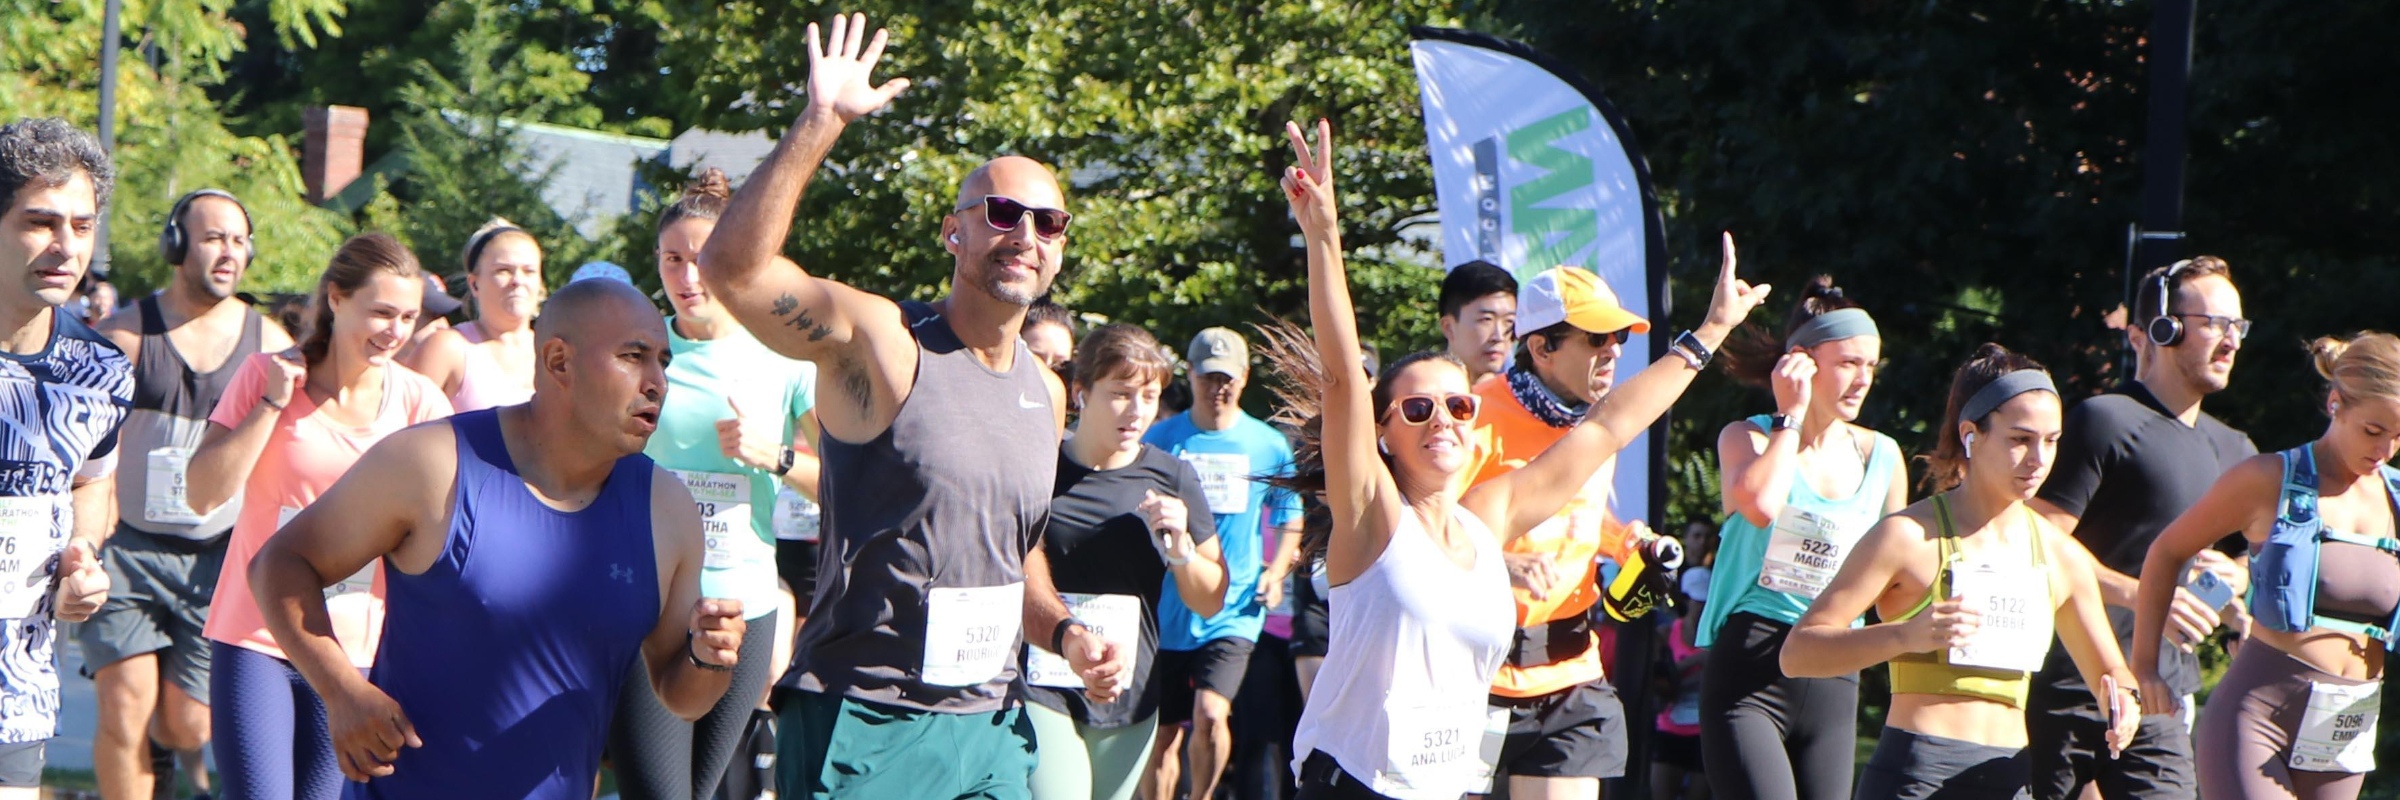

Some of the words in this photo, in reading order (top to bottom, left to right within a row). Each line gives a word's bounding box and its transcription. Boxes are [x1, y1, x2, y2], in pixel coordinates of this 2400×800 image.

[687, 480, 737, 490] MARATHON
[0, 508, 40, 518] RATHON
[1801, 539, 1840, 558] 5223
[1794, 552, 1838, 571] MAGGIE
[1800, 583, 1829, 593] TICKE
[1989, 595, 2026, 614] 5122
[1986, 614, 2026, 630] DEBBIE
[966, 624, 1001, 644] 5320
[1424, 727, 1459, 749] 5321
[1411, 752, 1438, 767] ANA
